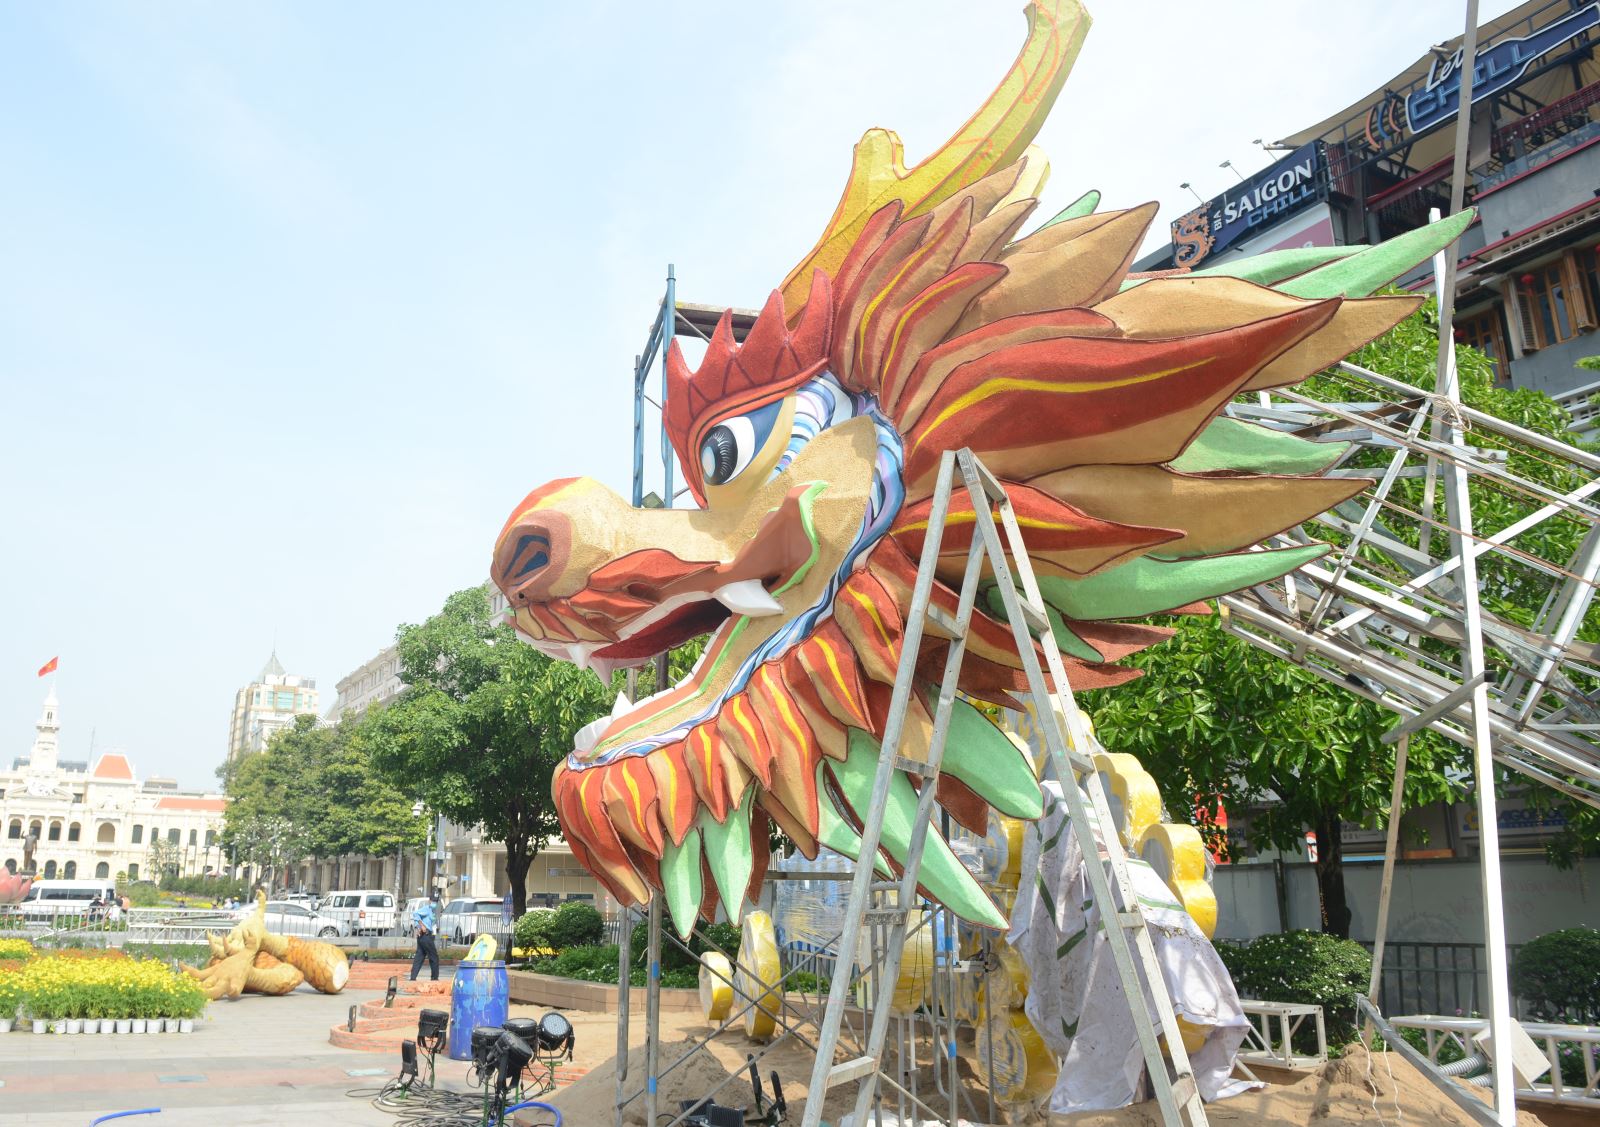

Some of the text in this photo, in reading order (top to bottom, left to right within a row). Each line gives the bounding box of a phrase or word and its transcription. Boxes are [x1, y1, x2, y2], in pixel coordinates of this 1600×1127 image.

[1213, 158, 1313, 231] BIA SAIGON
[1247, 183, 1316, 228] CHILL
